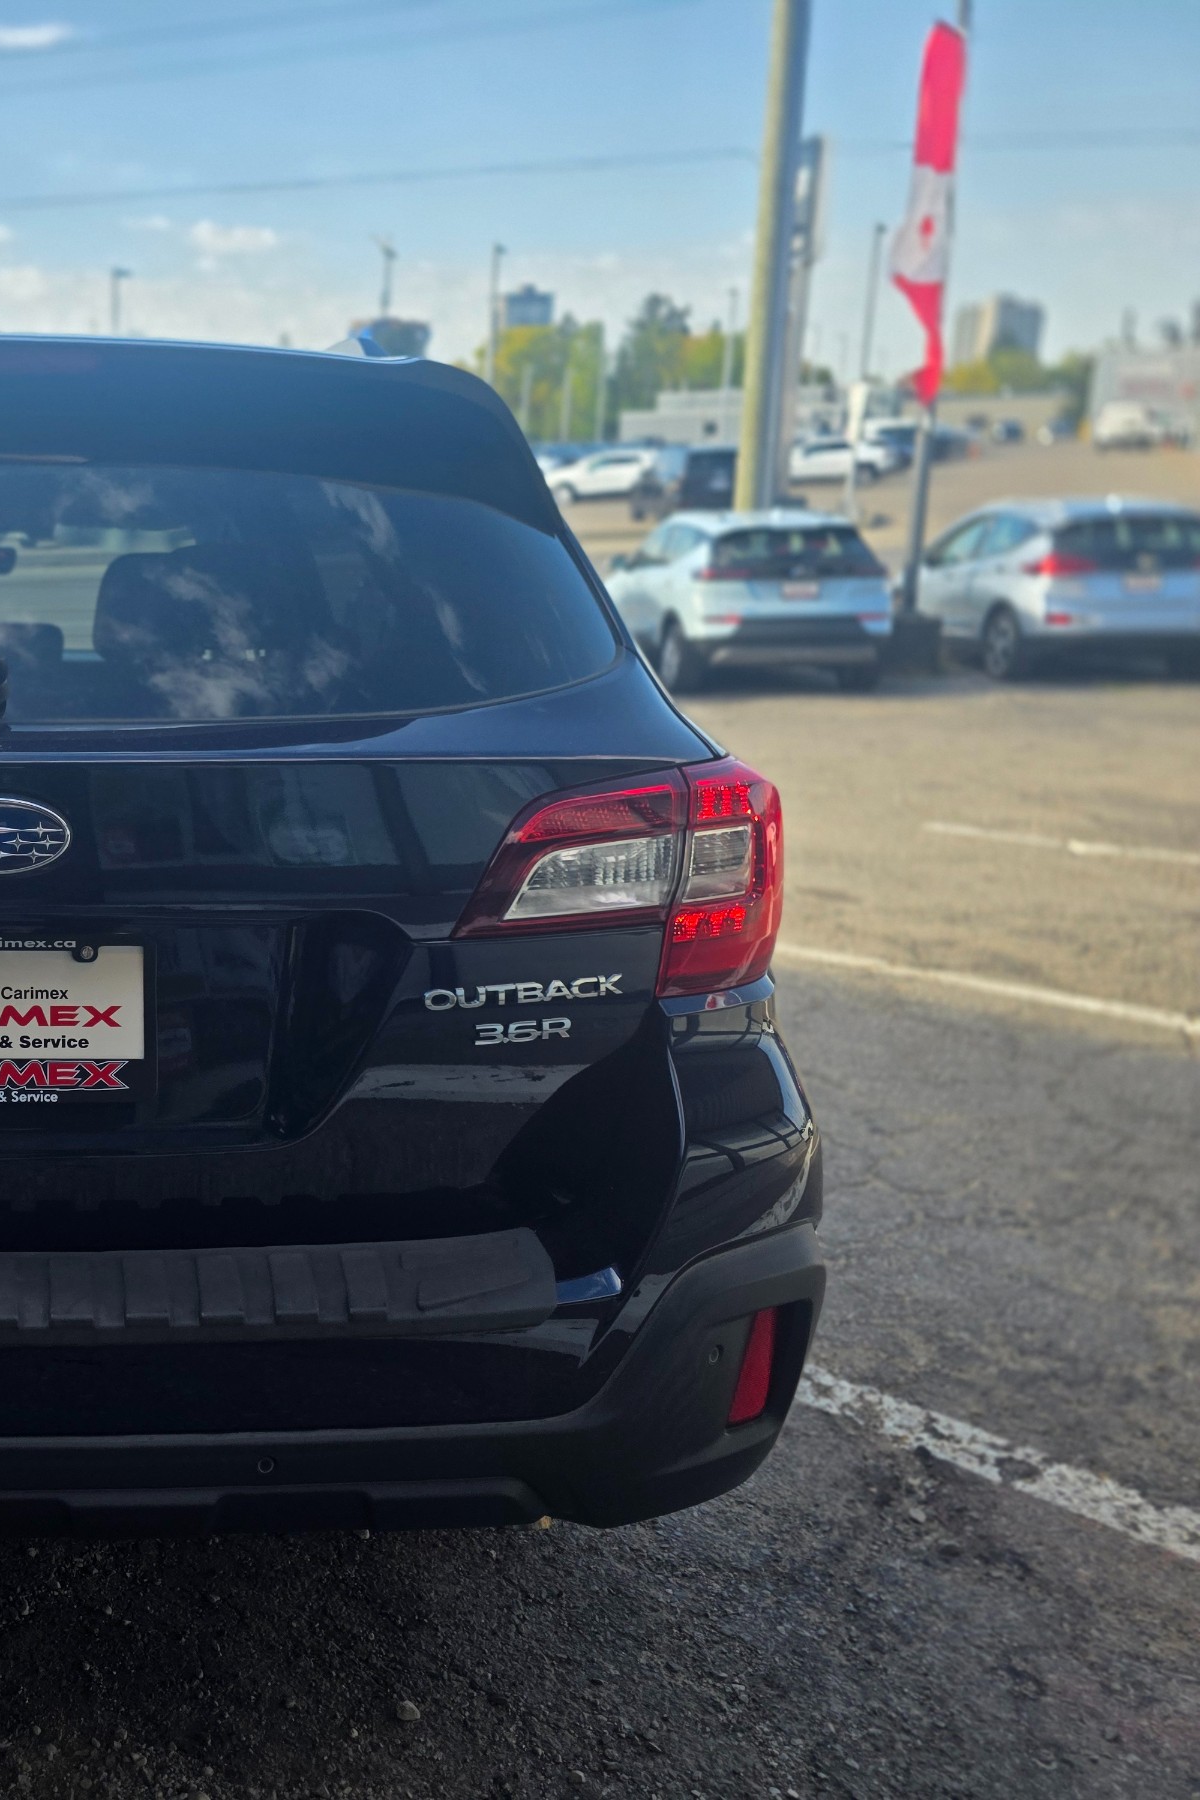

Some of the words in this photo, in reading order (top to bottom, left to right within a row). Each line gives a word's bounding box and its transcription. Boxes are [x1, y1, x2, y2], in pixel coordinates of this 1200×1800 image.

[0, 986, 69, 1000] Carimex
[423, 973, 623, 1011] OUTBACK
[474, 1016, 572, 1046] 3.6R
[0, 1035, 14, 1049] &
[19, 1035, 90, 1049] Service
[11, 1090, 59, 1104] Service
